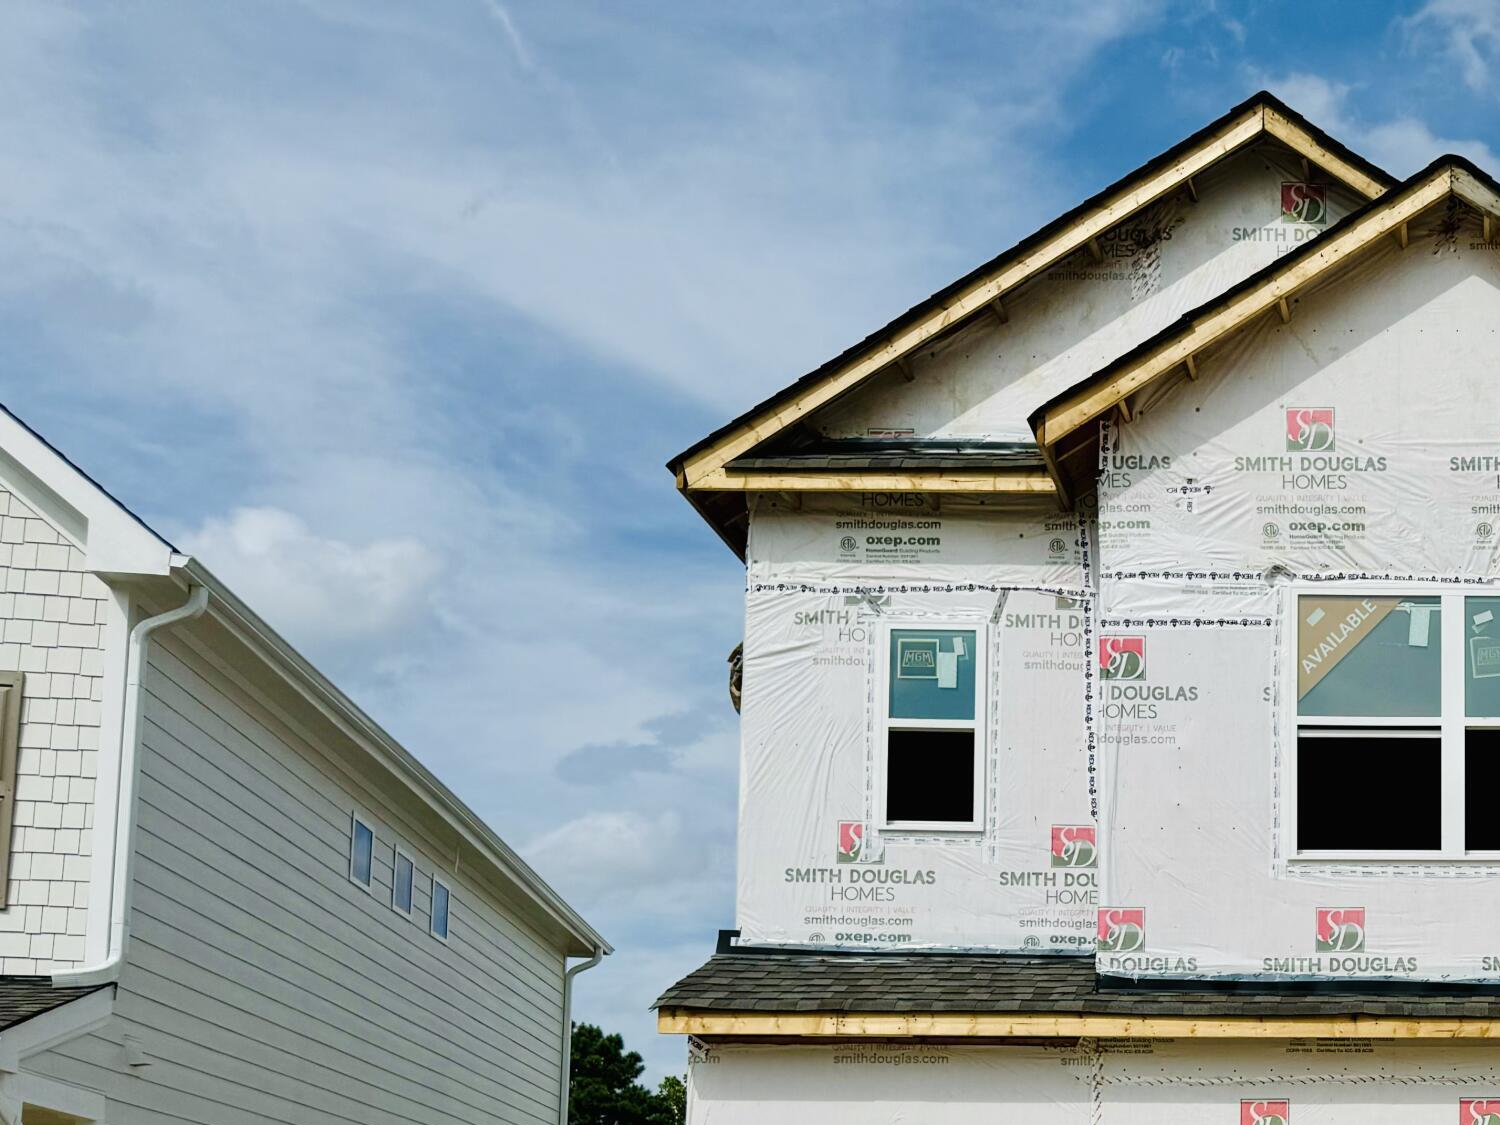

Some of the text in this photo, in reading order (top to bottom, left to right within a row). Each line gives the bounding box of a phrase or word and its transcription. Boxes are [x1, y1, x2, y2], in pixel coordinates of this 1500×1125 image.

[1232, 228, 1287, 242] SMITH
[1234, 456, 1388, 472] SMITH DOUGLAS
[1282, 474, 1348, 490] HOMES
[862, 491, 924, 507] HOMES
[1256, 504, 1367, 518] smithdouglas.com
[835, 519, 942, 531] smithdouglas.com
[1288, 520, 1366, 535] oxep.com
[865, 535, 941, 547] oxep.com
[793, 610, 849, 625] SMITH
[1005, 614, 1060, 629] SMITH
[1301, 598, 1378, 675] AVAILABLE
[1110, 686, 1199, 701] DOUGLAS
[784, 868, 936, 885] SMITH DOUGLAS
[999, 871, 1056, 887] SMITH
[831, 886, 895, 901] HOMES
[804, 914, 914, 928] smithdouglas.com
[835, 930, 912, 943] oxep.com
[1109, 957, 1198, 972] DOUGLAS
[1262, 957, 1418, 973] SMITH DOUGLAS
[833, 1052, 949, 1066] smithdouglas.com
